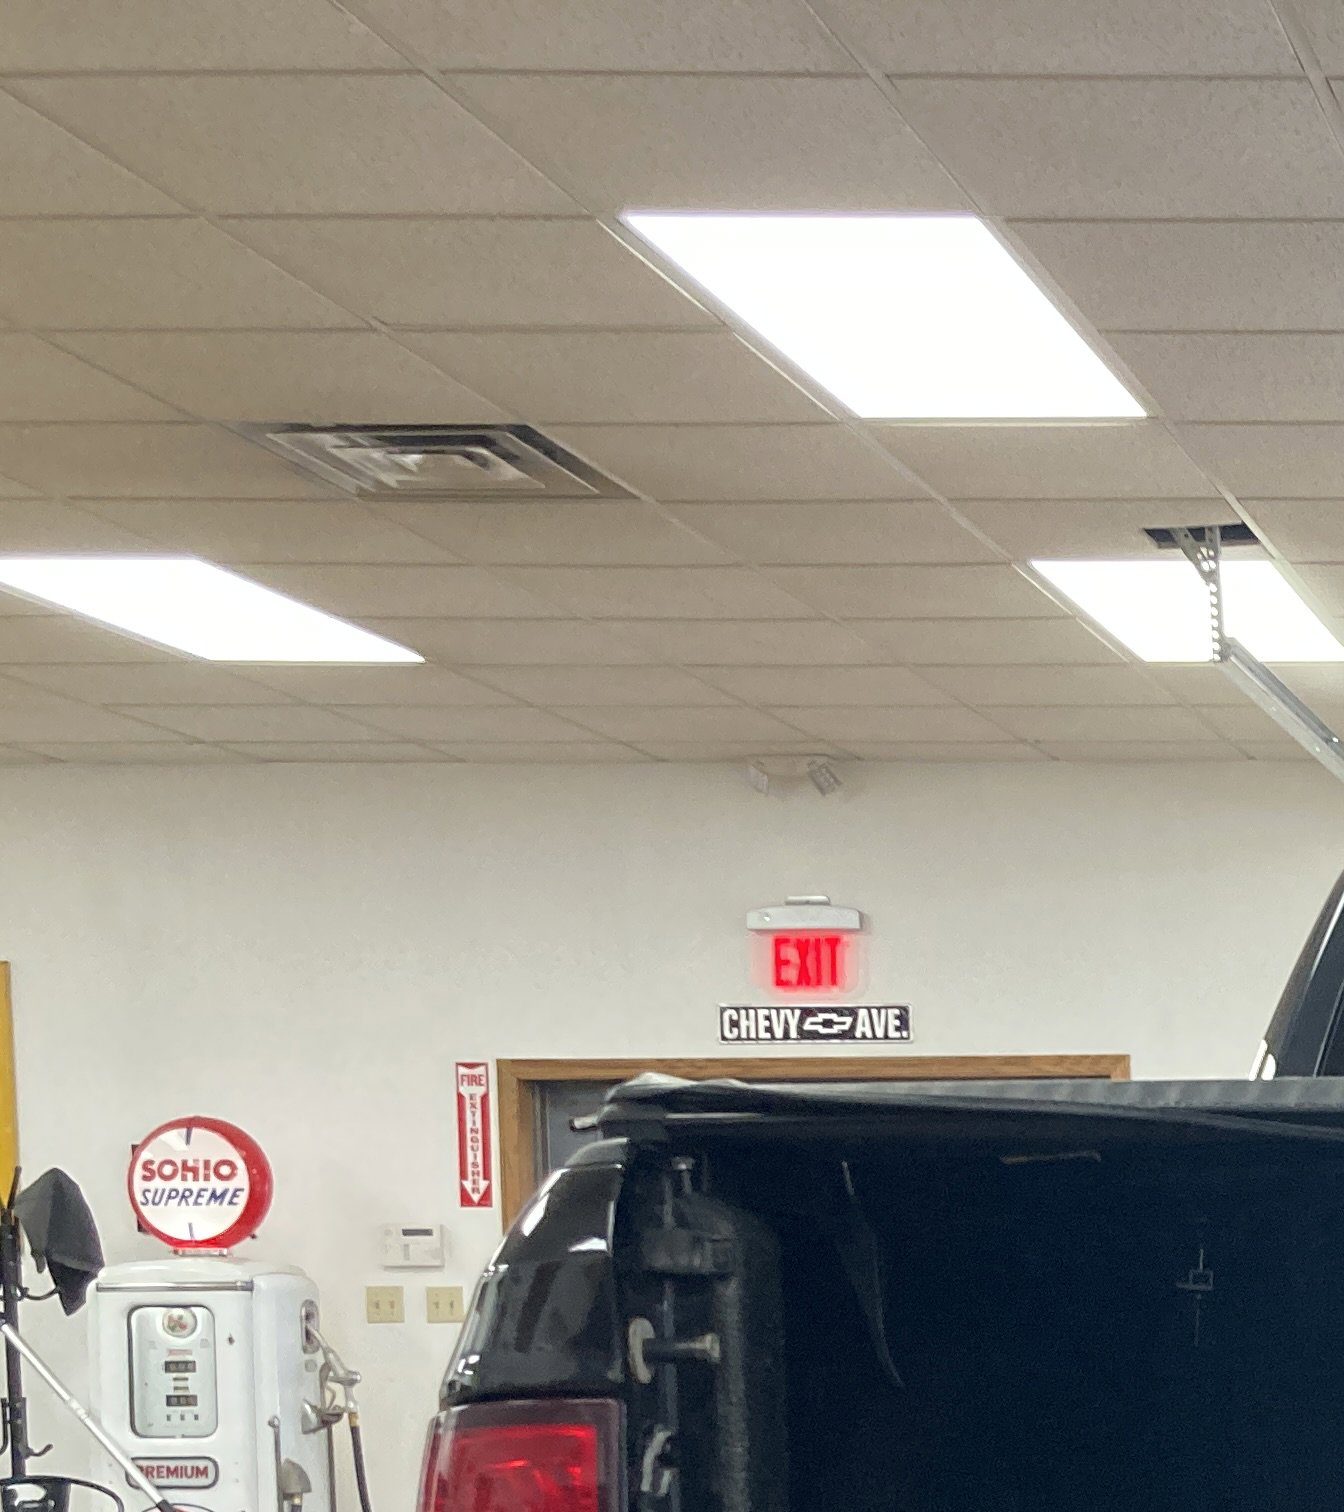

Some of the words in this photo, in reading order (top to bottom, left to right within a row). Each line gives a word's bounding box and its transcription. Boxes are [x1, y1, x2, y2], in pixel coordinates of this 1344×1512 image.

[773, 937, 841, 987] EXIT
[722, 1007, 800, 1040] CHEVY
[854, 1007, 909, 1040] AVE.
[460, 1073, 485, 1087] FIRE
[468, 1092, 481, 1195] EXTINGUISHER
[141, 1158, 239, 1182] SOHIO
[140, 1187, 245, 1207] SUPREME
